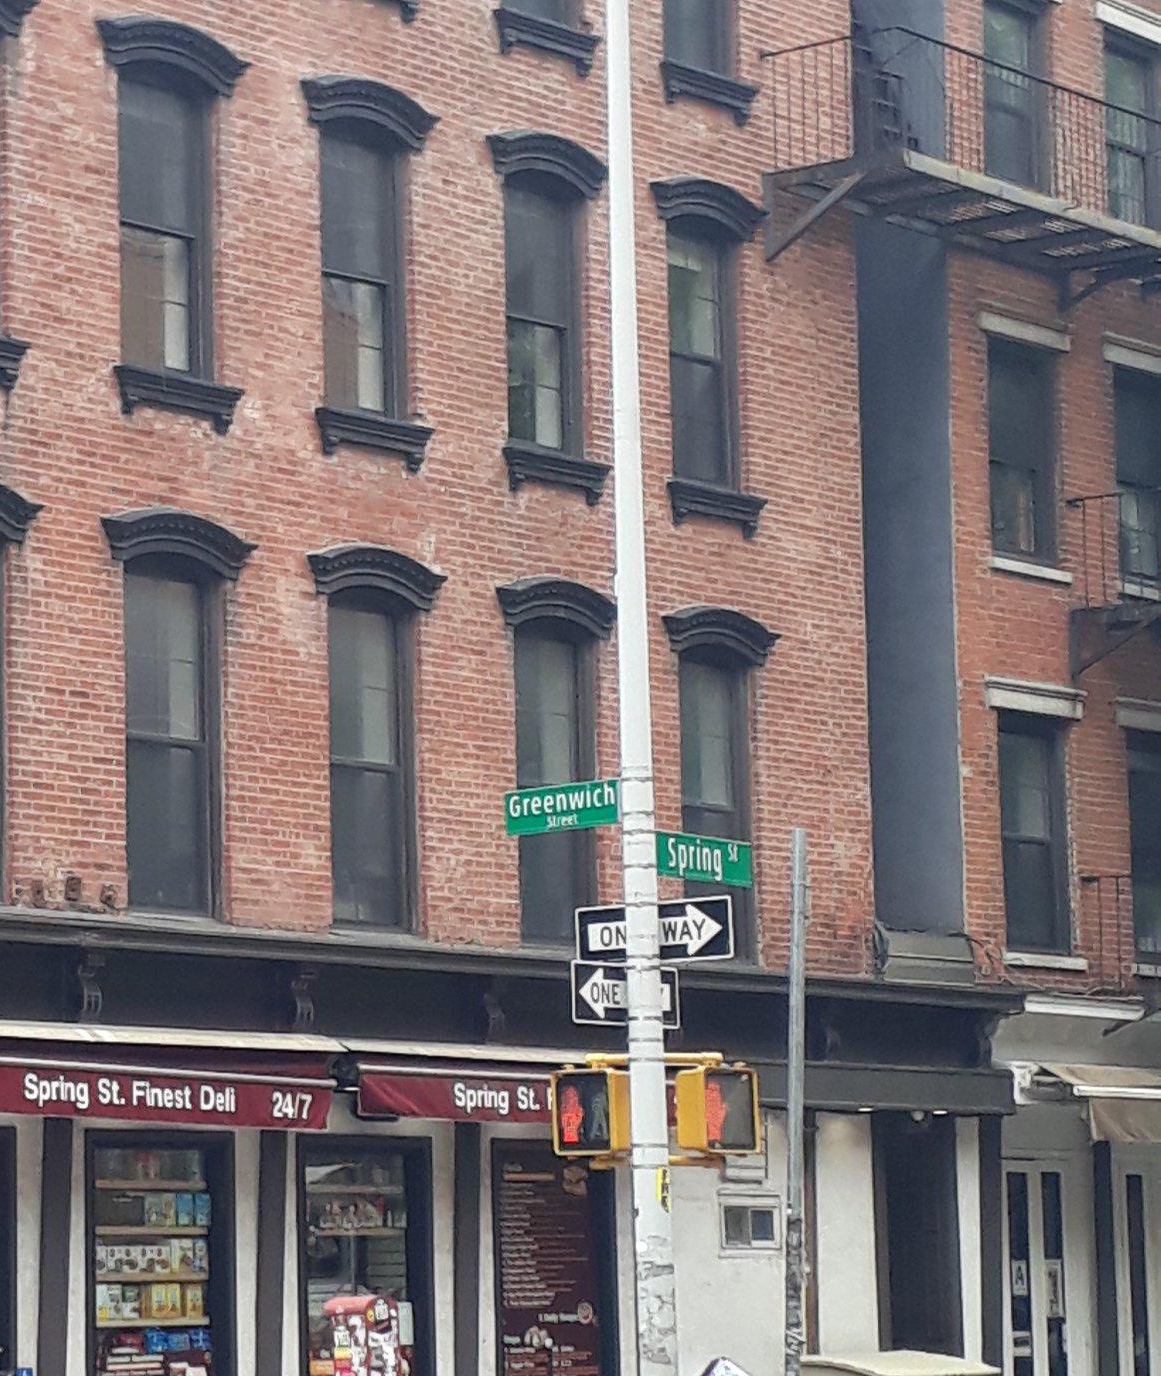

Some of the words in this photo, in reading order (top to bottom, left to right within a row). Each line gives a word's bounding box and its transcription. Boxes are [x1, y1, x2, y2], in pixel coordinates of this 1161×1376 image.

[509, 783, 616, 818] Greenwich
[546, 813, 578, 828] Street
[668, 837, 723, 881] Spring
[728, 842, 739, 863] St
[600, 926, 626, 948] ON
[662, 917, 706, 943] WAY
[590, 981, 621, 1005] ONE
[24, 1073, 89, 1109] Spring
[97, 1077, 126, 1106] St.
[132, 1081, 192, 1110] Finest
[199, 1085, 236, 1113] Deli
[272, 1091, 313, 1120] 24/7
[453, 1082, 510, 1115] Spring
[517, 1085, 541, 1110] St.
[1015, 1265, 1026, 1286] A
